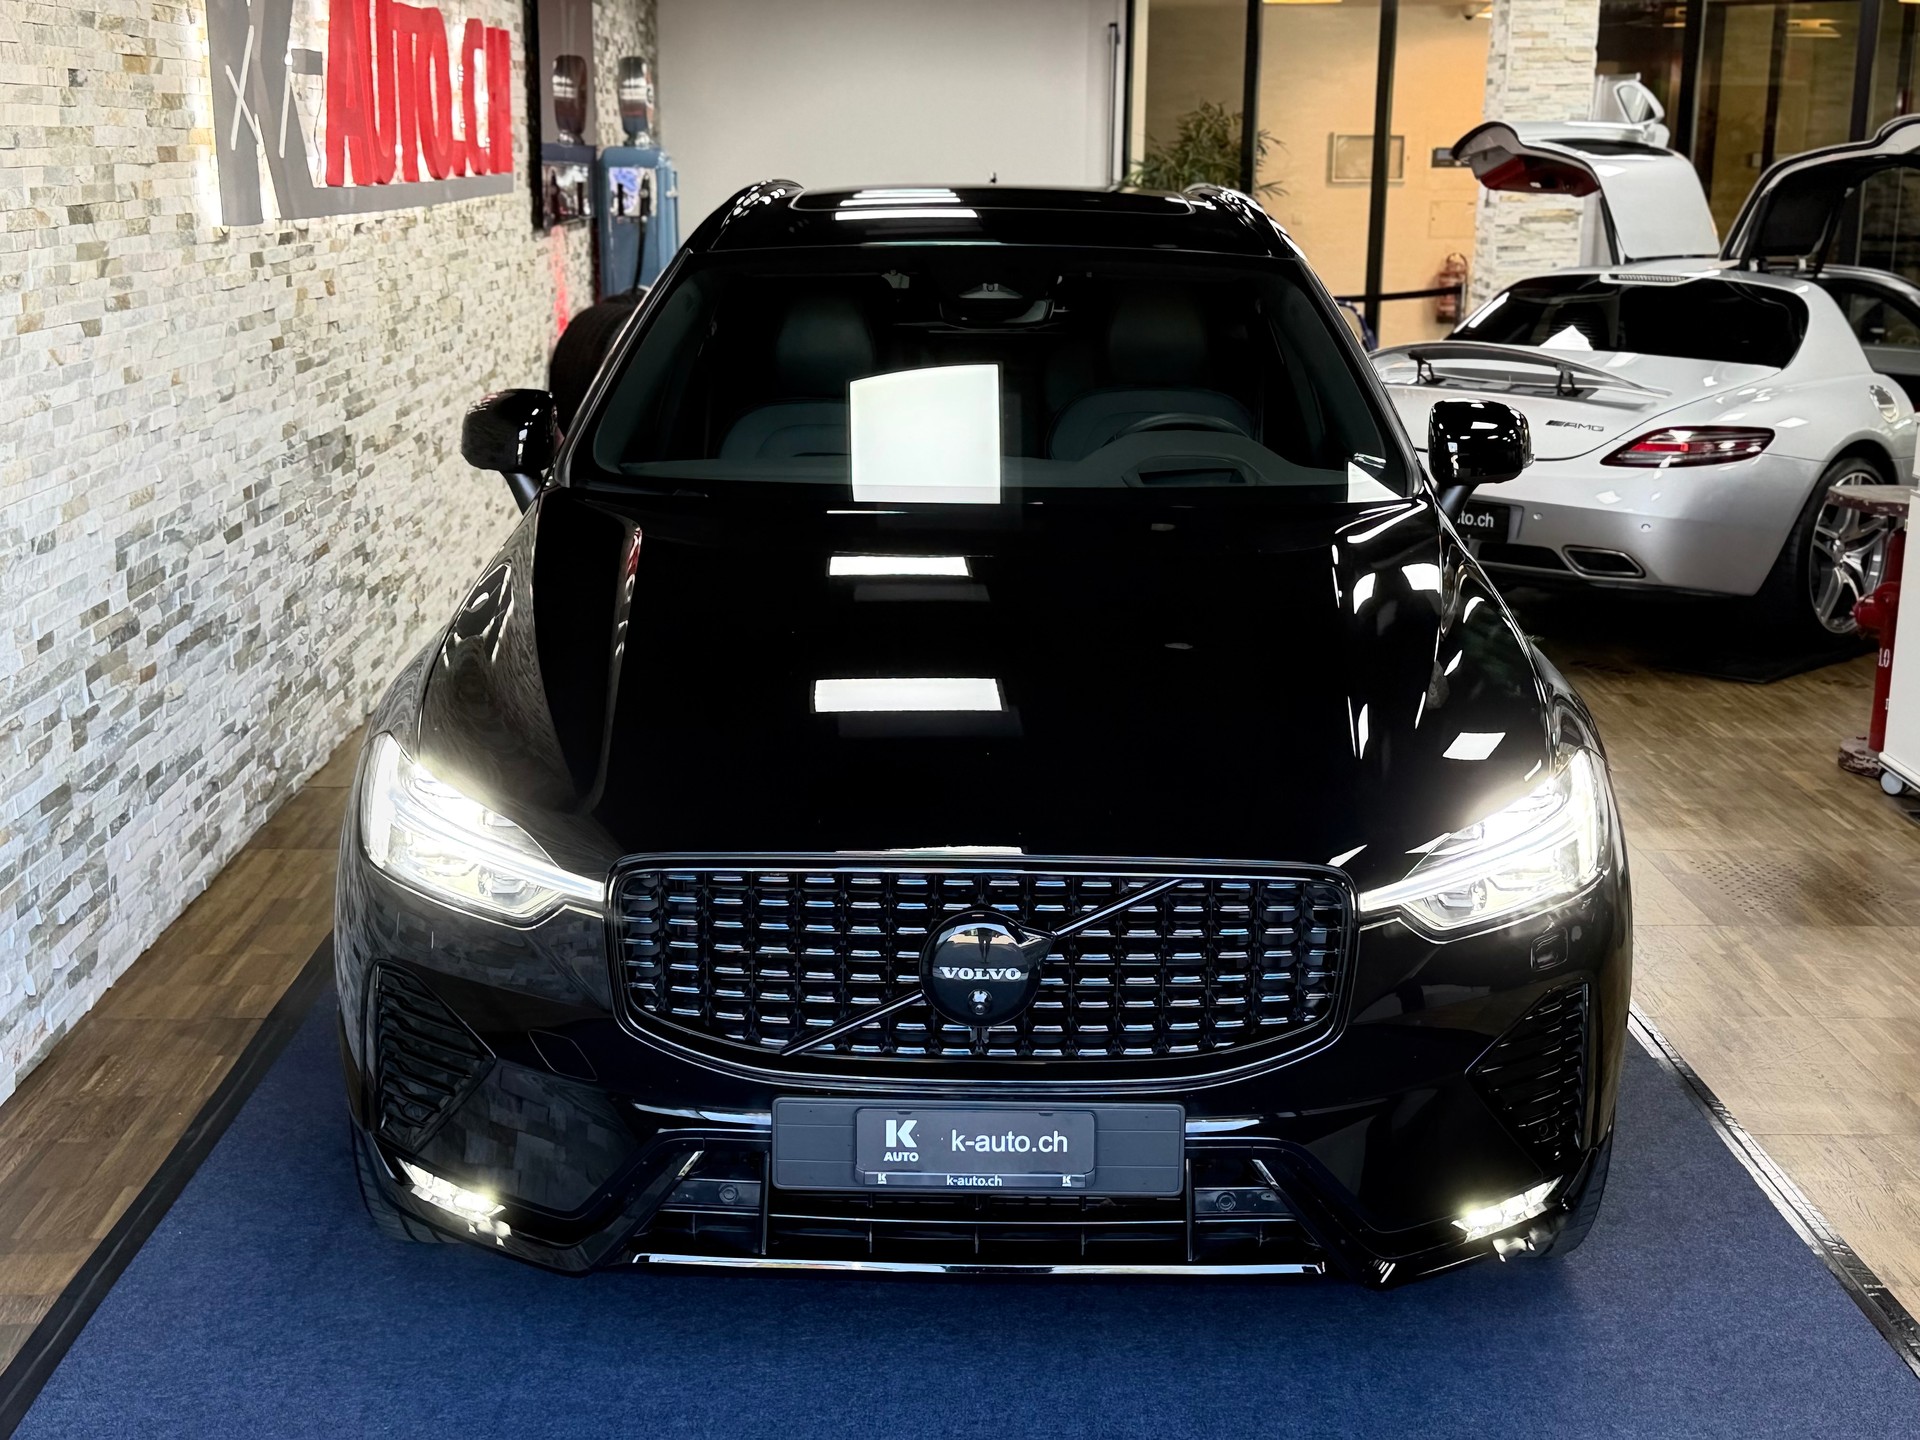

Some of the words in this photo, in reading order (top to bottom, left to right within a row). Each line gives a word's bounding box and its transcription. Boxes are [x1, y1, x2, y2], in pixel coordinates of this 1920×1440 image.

[1457, 510, 1494, 528] to.ch
[939, 966, 1022, 980] VOLVO
[885, 1120, 918, 1148] K
[951, 1129, 1068, 1153] k-auto.ch
[883, 1151, 919, 1162] AUTO
[946, 1174, 1003, 1187] k-auto.ch
